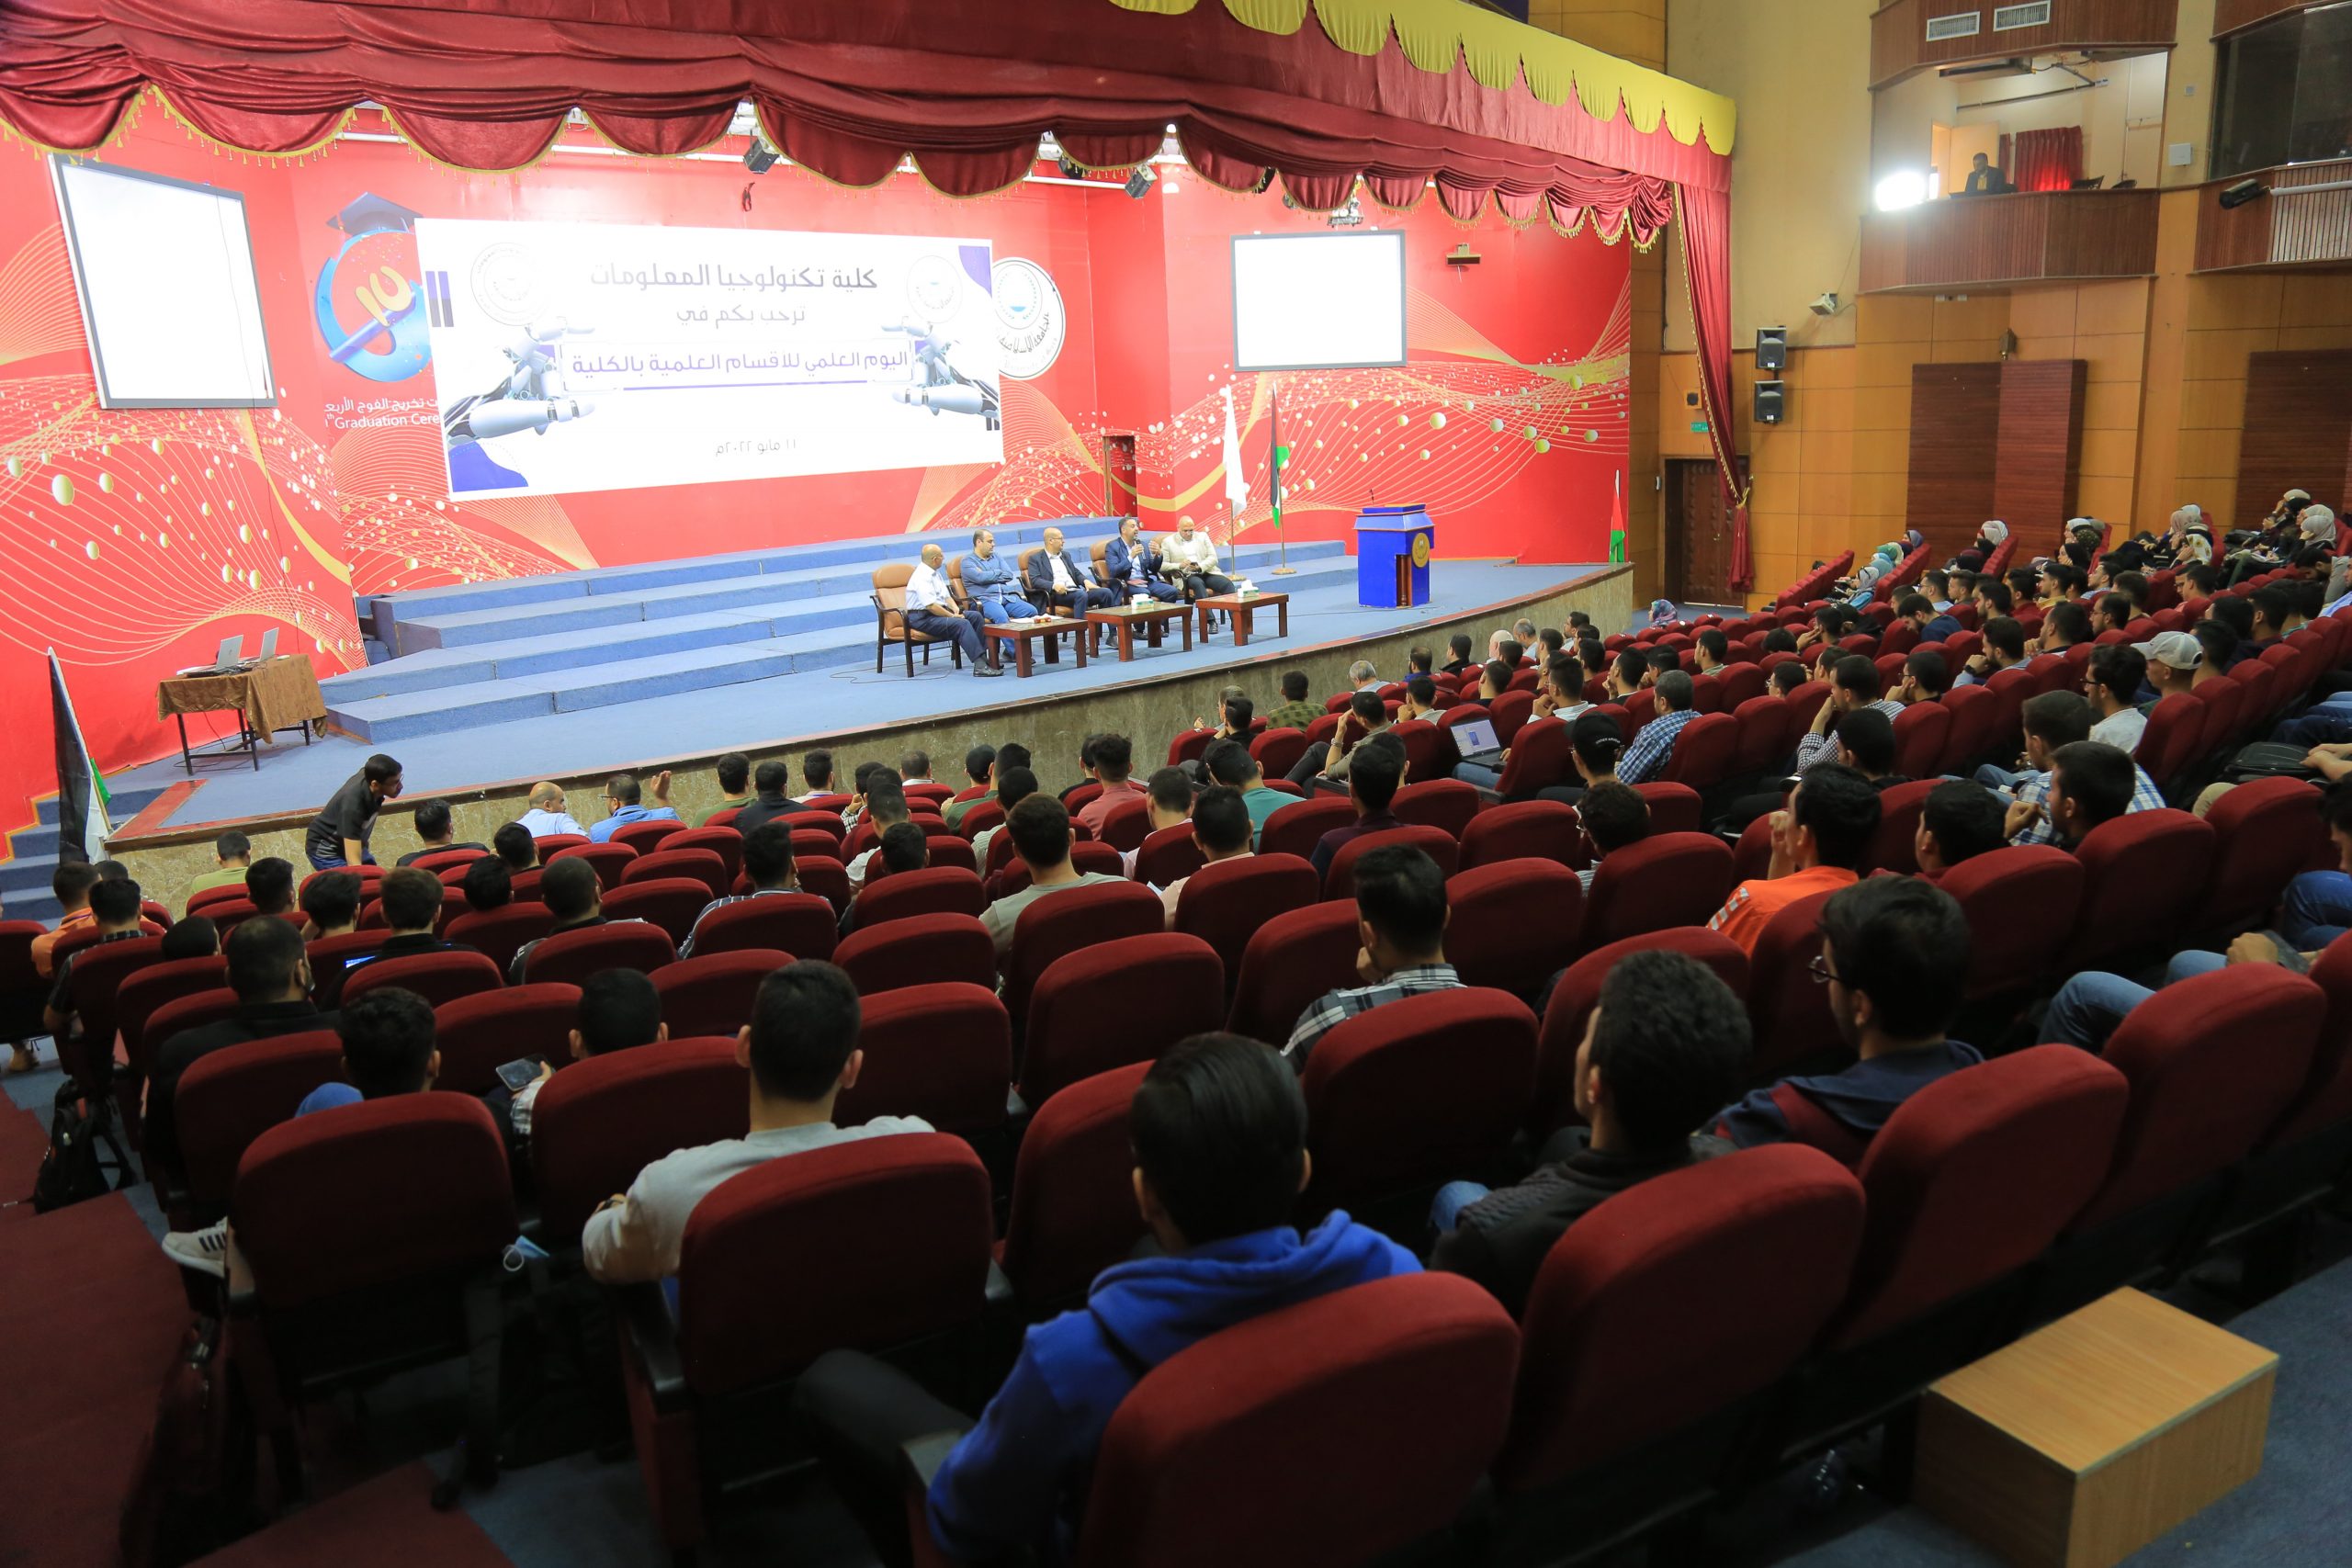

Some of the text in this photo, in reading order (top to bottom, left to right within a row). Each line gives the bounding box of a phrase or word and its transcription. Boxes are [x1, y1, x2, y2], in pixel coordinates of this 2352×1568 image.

[590, 262, 878, 293] كلية تكنولوجيا المعلومات
[676, 304, 807, 330] ترحب بكم في
[572, 354, 644, 378] بالكلية
[649, 353, 721, 377] العلمية
[805, 352, 861, 376] العلمي
[864, 351, 908, 373] اليوم
[357, 398, 389, 413] الفوج
[334, 415, 408, 429] Graduation
[411, 413, 439, 425] Cere
